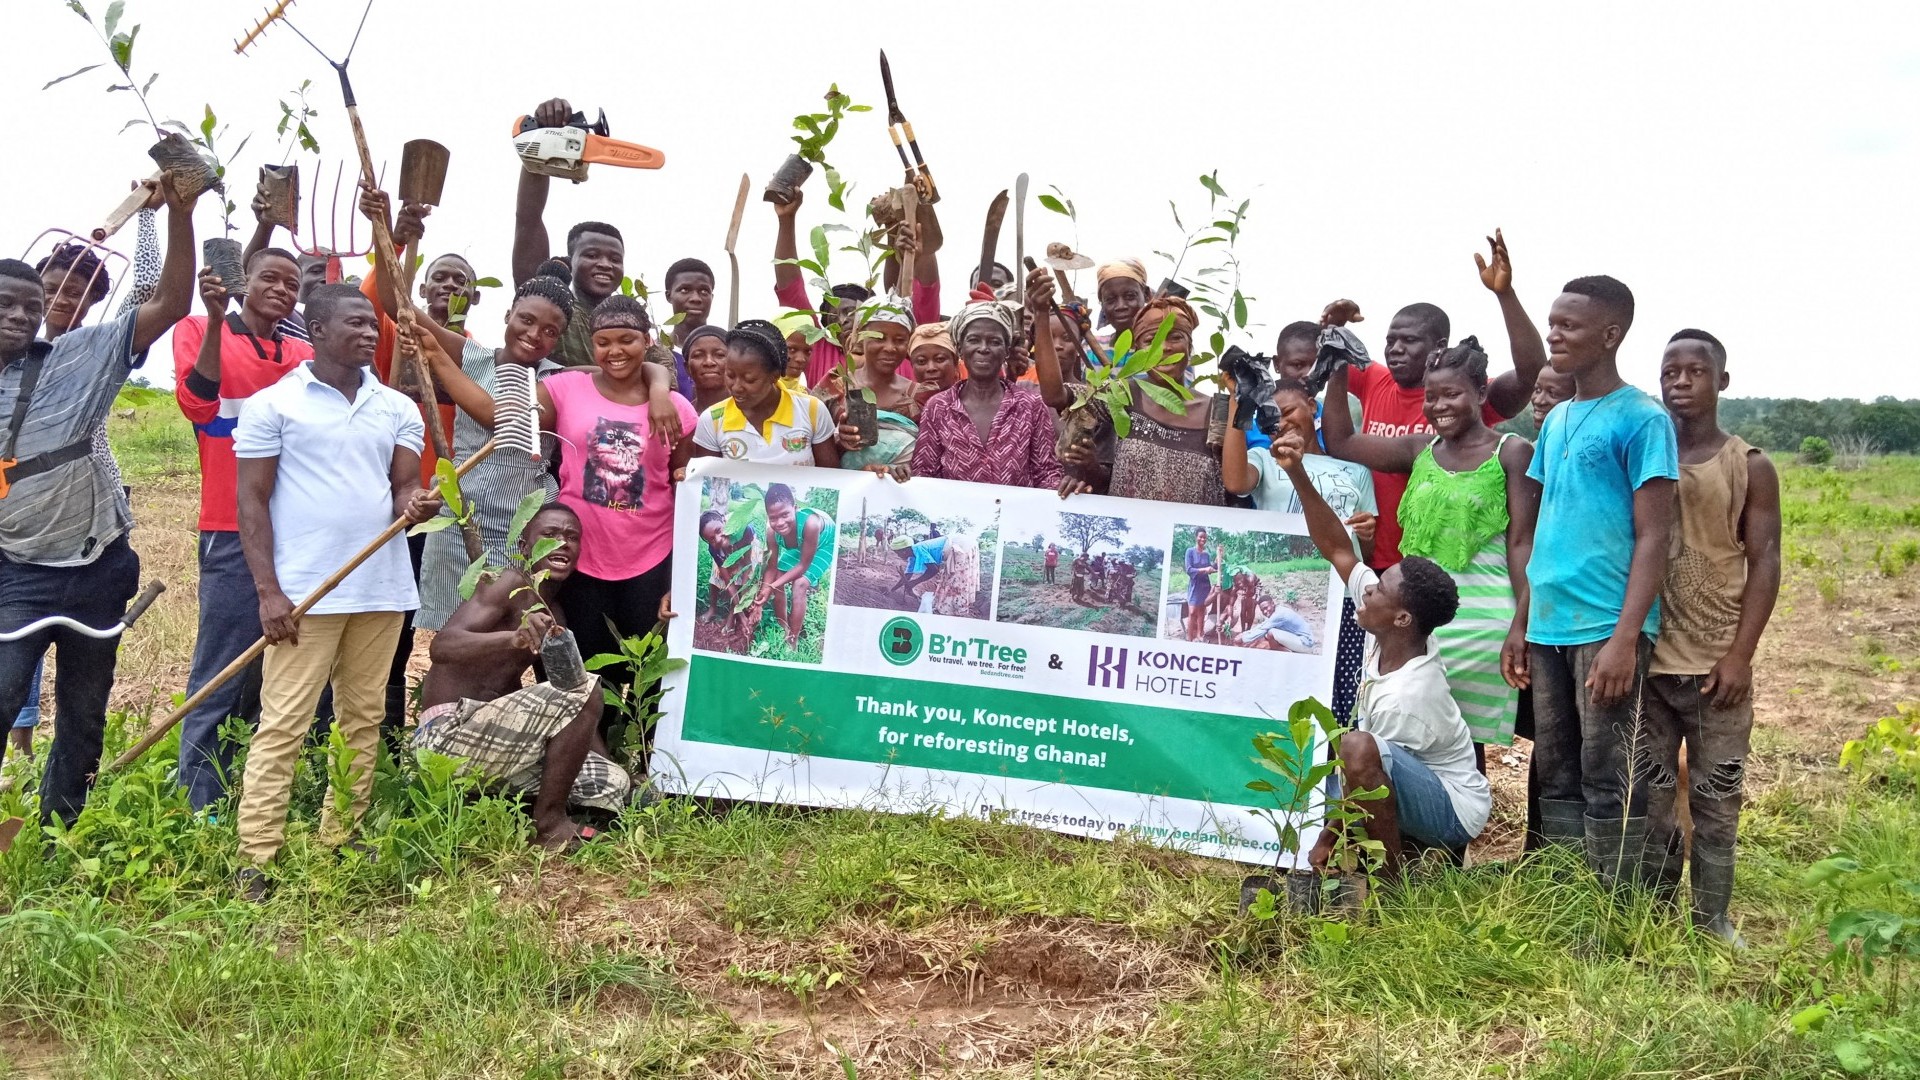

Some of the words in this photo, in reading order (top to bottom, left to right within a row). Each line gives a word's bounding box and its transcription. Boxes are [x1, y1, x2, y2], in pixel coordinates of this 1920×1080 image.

[1367, 420, 1438, 438] EROCLEA
[928, 633, 1028, 664] B'n'Tree
[1047, 653, 1063, 670] &
[928, 654, 942, 663] You
[979, 660, 995, 669] tree.
[997, 662, 1010, 671] For
[1010, 663, 1026, 673] free!
[1137, 650, 1243, 677] KONCEPT
[1135, 674, 1217, 699] HOTELS
[855, 695, 919, 718] Thank
[922, 705, 967, 726] you,
[972, 708, 1057, 736] Koncept
[1062, 718, 1135, 746] Hotels,
[878, 726, 909, 745] for
[913, 731, 1029, 763] reforesting
[1034, 744, 1107, 768] Ghana!
[1021, 809, 1059, 823] trees
[1063, 814, 1106, 832] today
[1107, 821, 1126, 832] on
[1130, 823, 1292, 853] wwwbedantree.co
